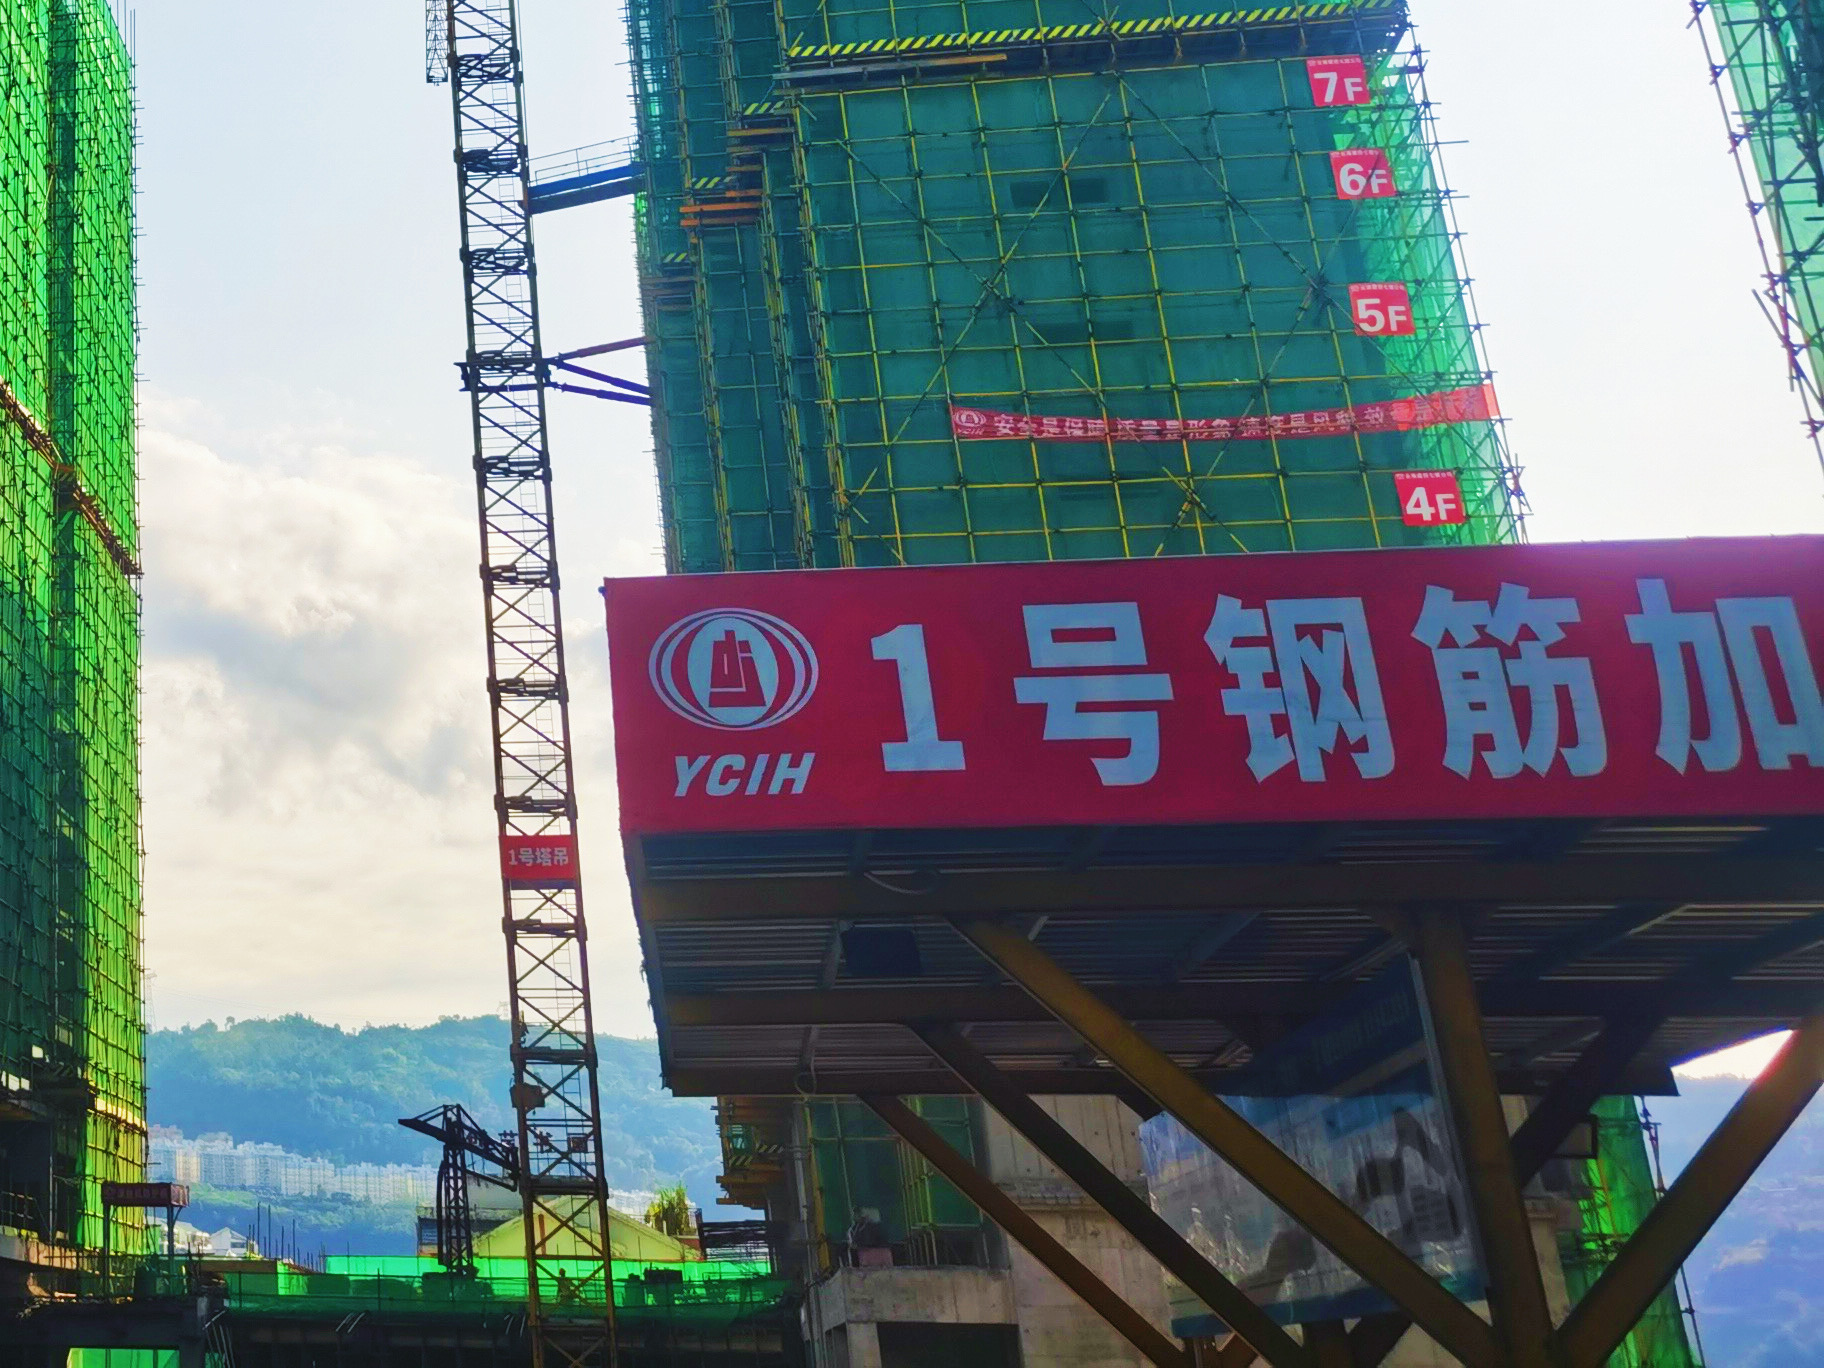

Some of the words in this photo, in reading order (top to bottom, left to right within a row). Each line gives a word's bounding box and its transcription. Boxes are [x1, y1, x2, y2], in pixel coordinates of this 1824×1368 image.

[1313, 72, 1363, 103] 7F
[1339, 163, 1388, 196] 6F
[1357, 298, 1408, 332] 5F
[1406, 487, 1457, 521] 4F
[870, 578, 1824, 788] 1号钢筋加
[673, 752, 816, 797] YCIH
[508, 847, 569, 867] 1号塔吊
